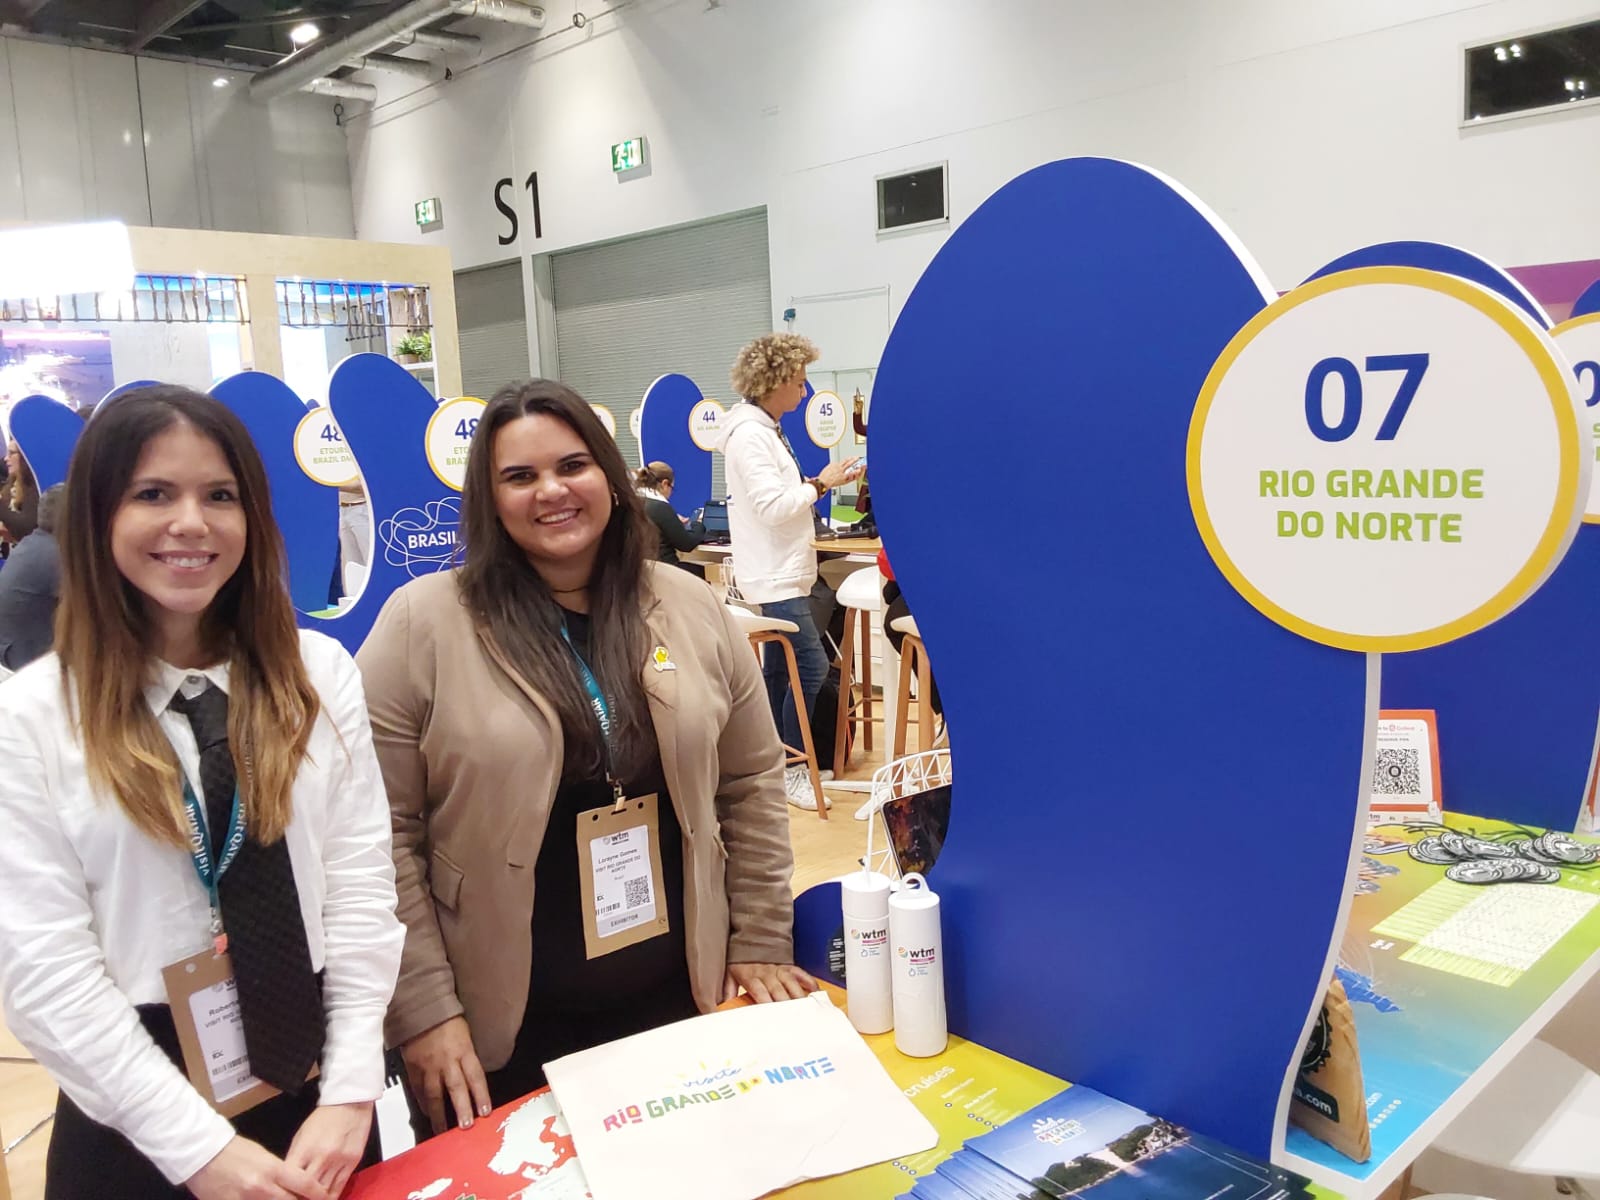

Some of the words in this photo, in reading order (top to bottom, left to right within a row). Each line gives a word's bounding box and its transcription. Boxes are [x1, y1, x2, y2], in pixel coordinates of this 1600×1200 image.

[1304, 352, 1430, 443] 07
[703, 410, 715, 422] 44
[820, 403, 833, 416] 45
[1259, 470, 1315, 497] RIO
[1326, 468, 1484, 499] GRANDE
[1277, 510, 1324, 537] DO
[1336, 511, 1462, 542] NORTE
[862, 929, 887, 939] wtm
[910, 948, 935, 958] wtm
[764, 1057, 836, 1085] NORTE
